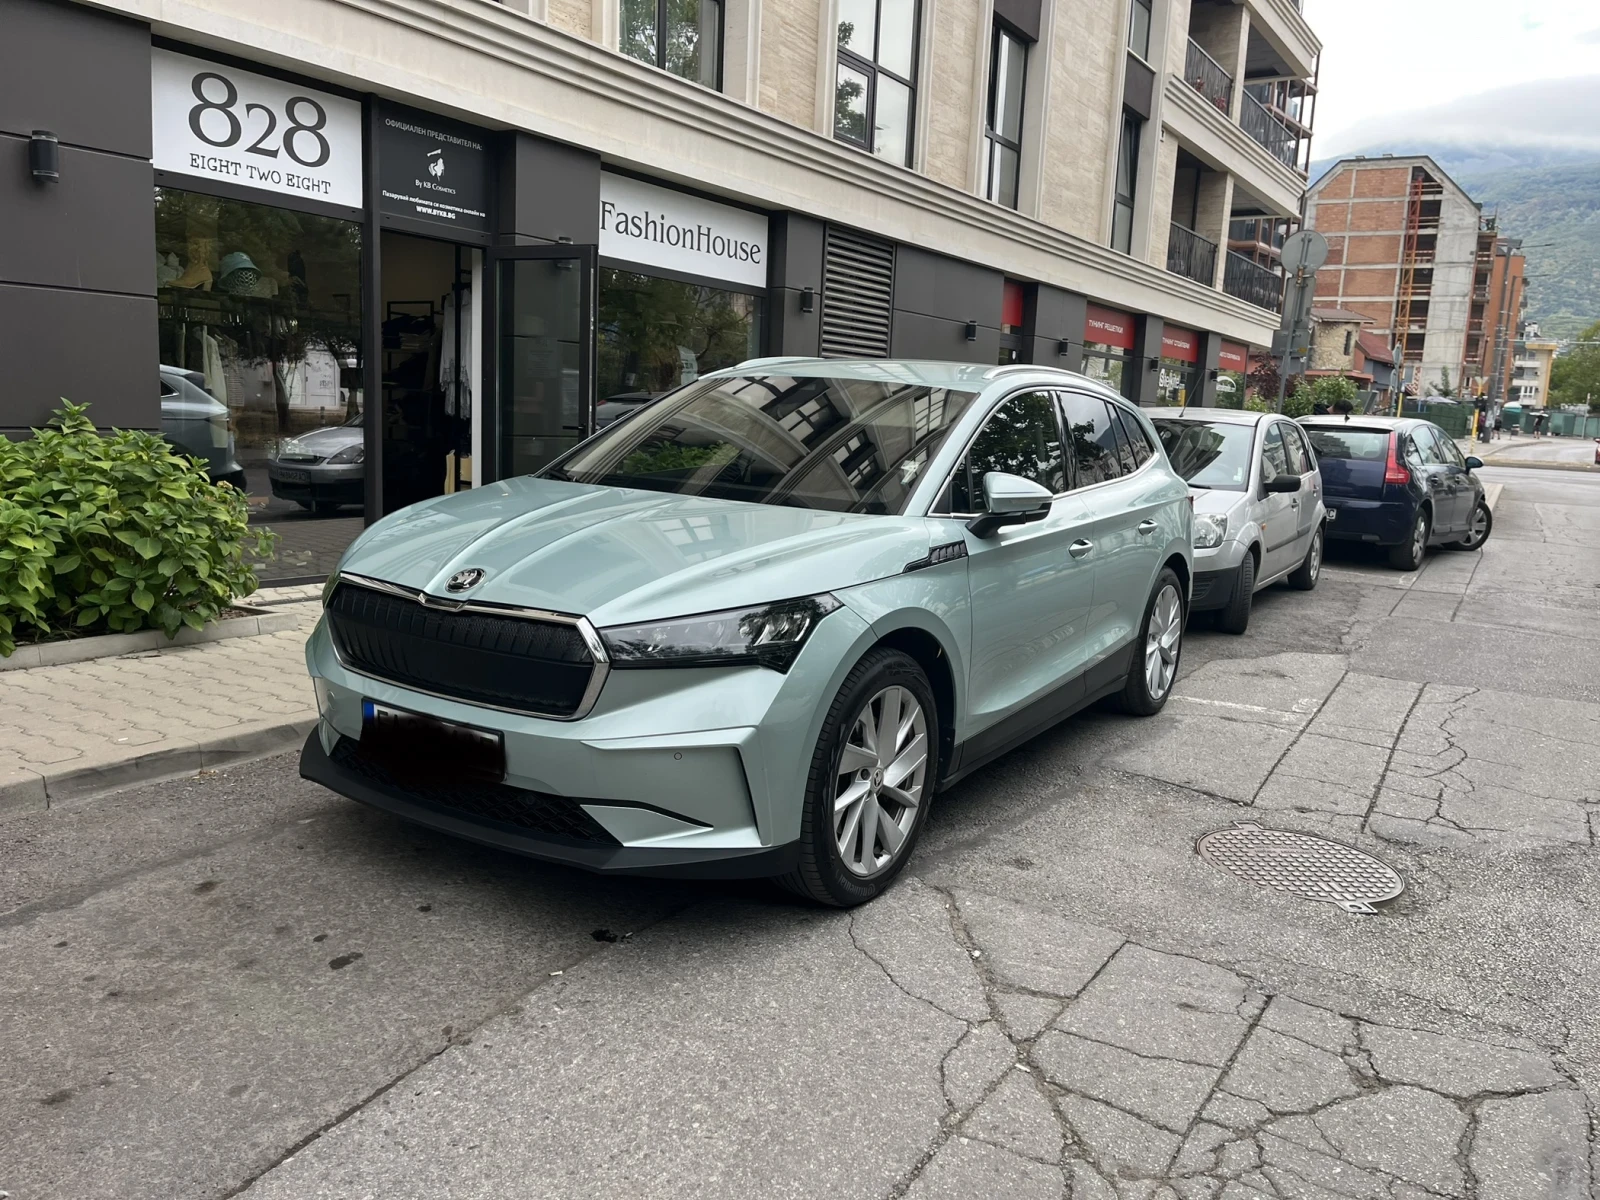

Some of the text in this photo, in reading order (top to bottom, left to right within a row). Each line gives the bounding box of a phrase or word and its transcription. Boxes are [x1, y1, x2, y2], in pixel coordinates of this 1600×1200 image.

[188, 72, 330, 168] 828
[385, 118, 426, 136] ОФИЦИАЛЕН
[427, 130, 472, 148] ПРЕДСТАВИТЕЛ
[189, 153, 331, 195] EIGHT TWO EIGHT
[415, 179, 423, 189] By
[423, 181, 432, 189] KB
[382, 190, 409, 201] Пазарувай
[601, 201, 761, 264] FashionHouse
